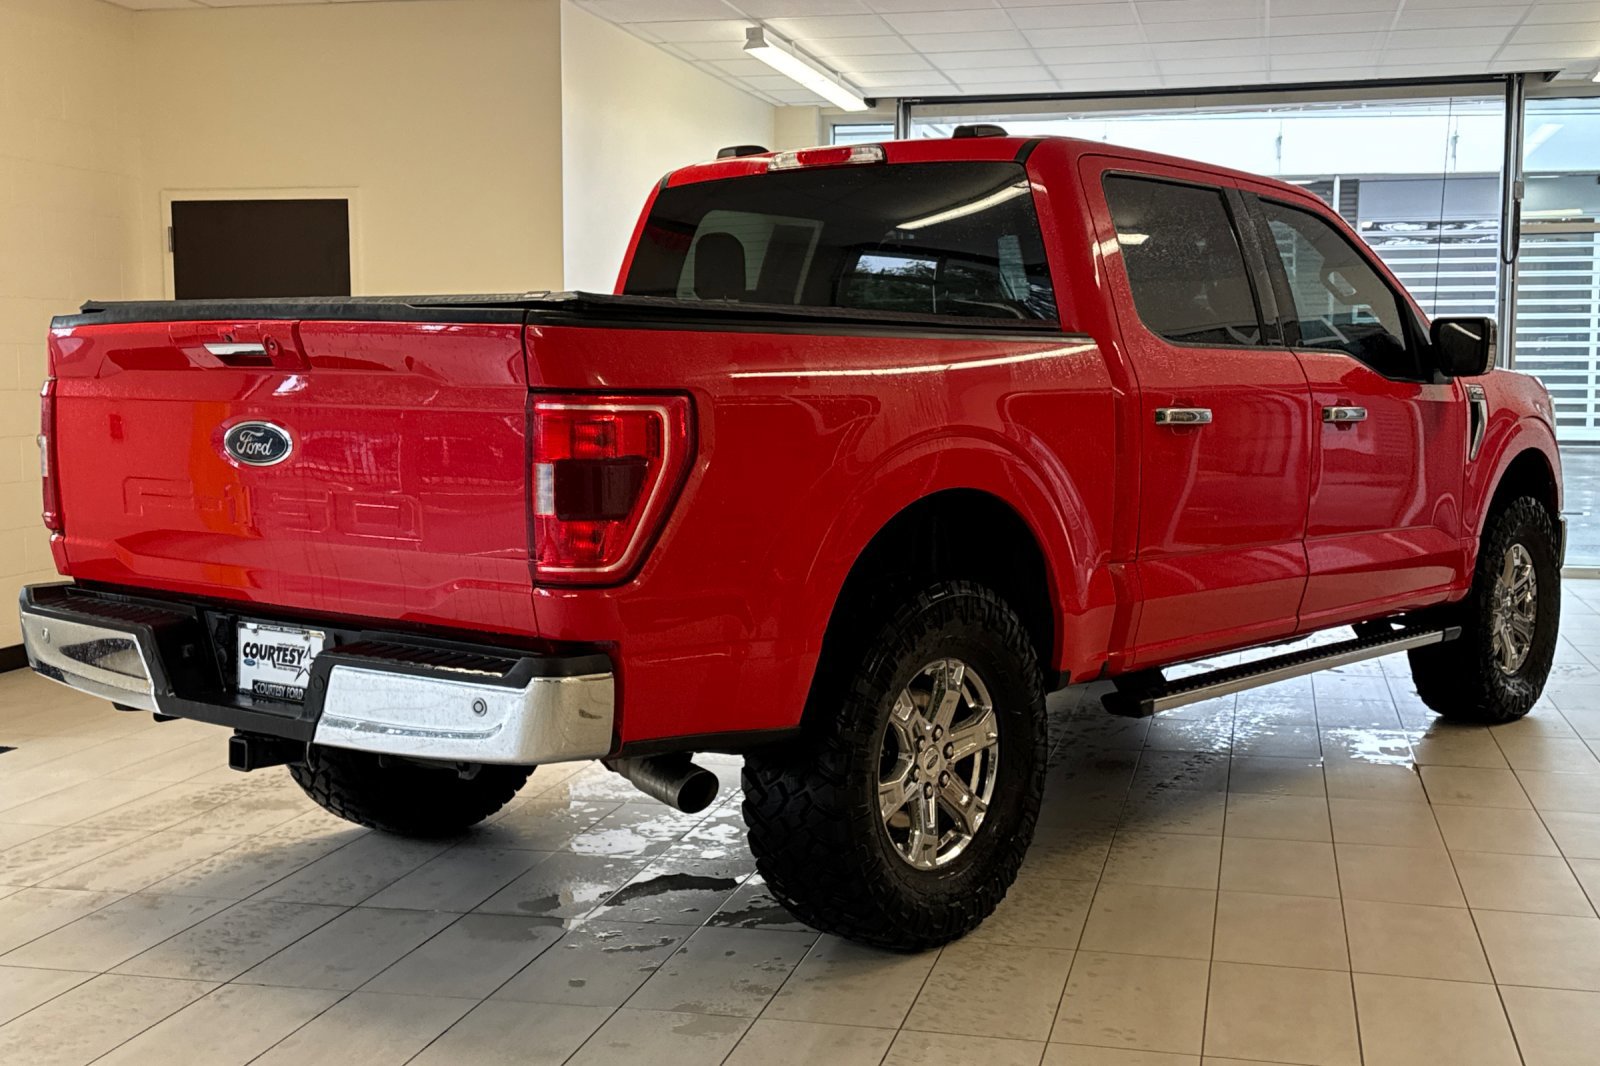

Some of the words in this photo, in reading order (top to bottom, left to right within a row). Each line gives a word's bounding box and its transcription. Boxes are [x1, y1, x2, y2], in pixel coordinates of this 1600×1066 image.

[236, 429, 273, 456] Ford
[243, 641, 305, 668] COURTESY
[255, 682, 286, 697] COURTESY
[286, 686, 304, 699] FORD
